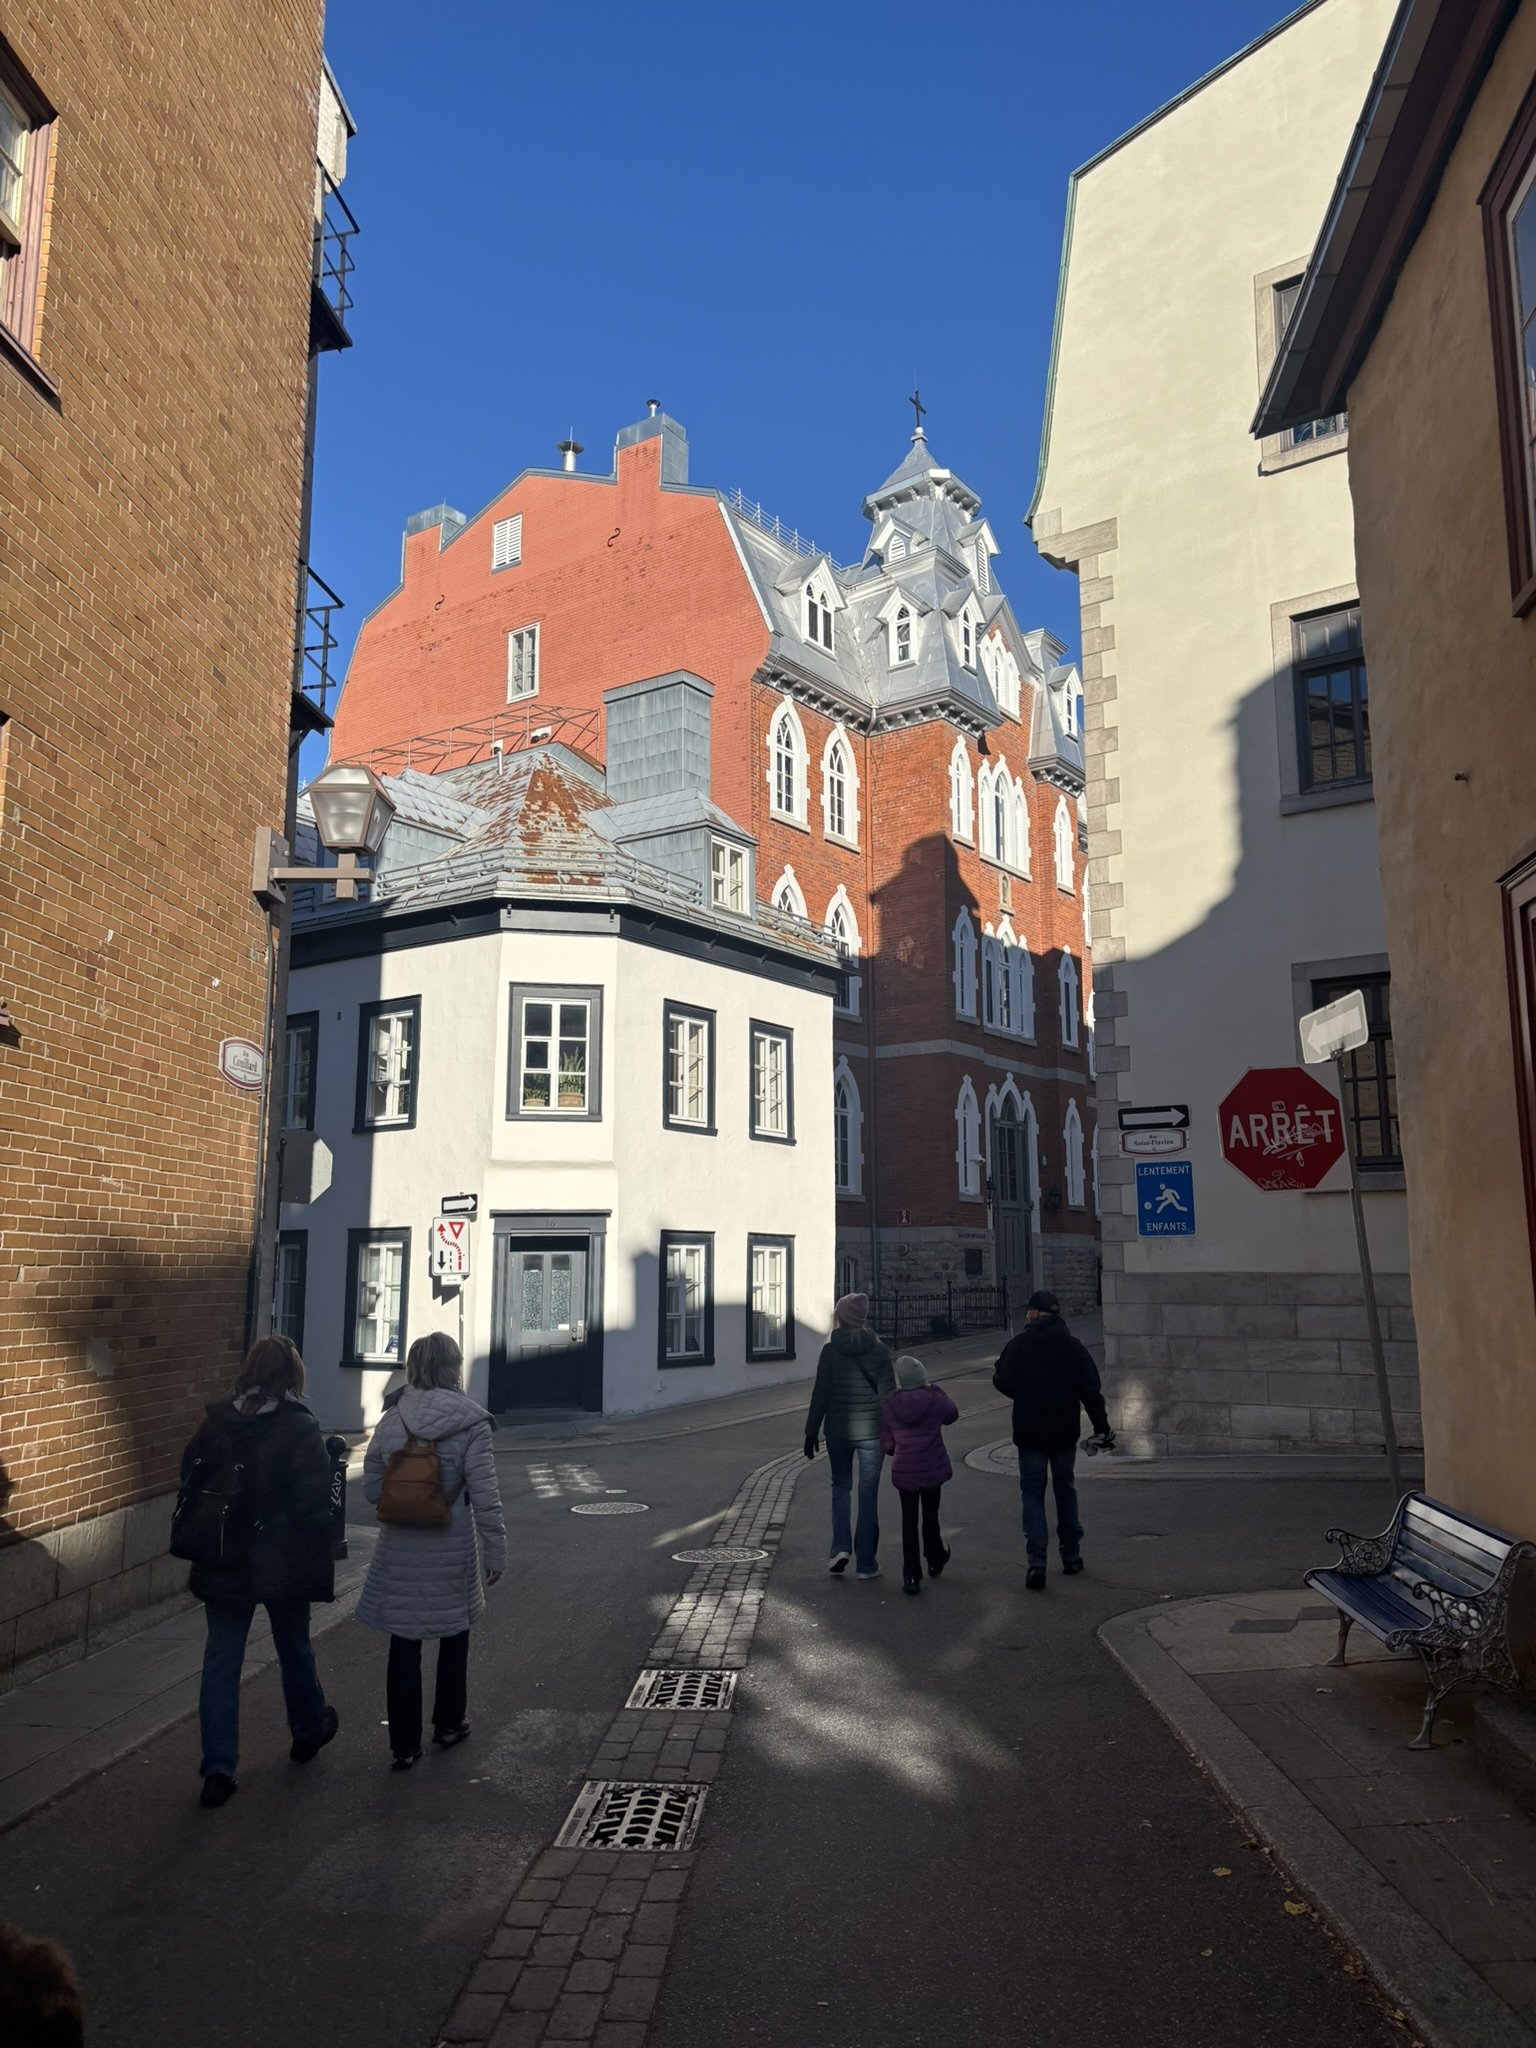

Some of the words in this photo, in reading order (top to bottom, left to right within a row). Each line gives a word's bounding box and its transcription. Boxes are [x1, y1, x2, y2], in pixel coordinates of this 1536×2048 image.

[1229, 1104, 1335, 1149] ARRÊT
[1133, 1138, 1174, 1146] Saint-Flavien
[1138, 1165, 1190, 1176] LENTEMENT
[1146, 1222, 1187, 1231] ENFANTS
